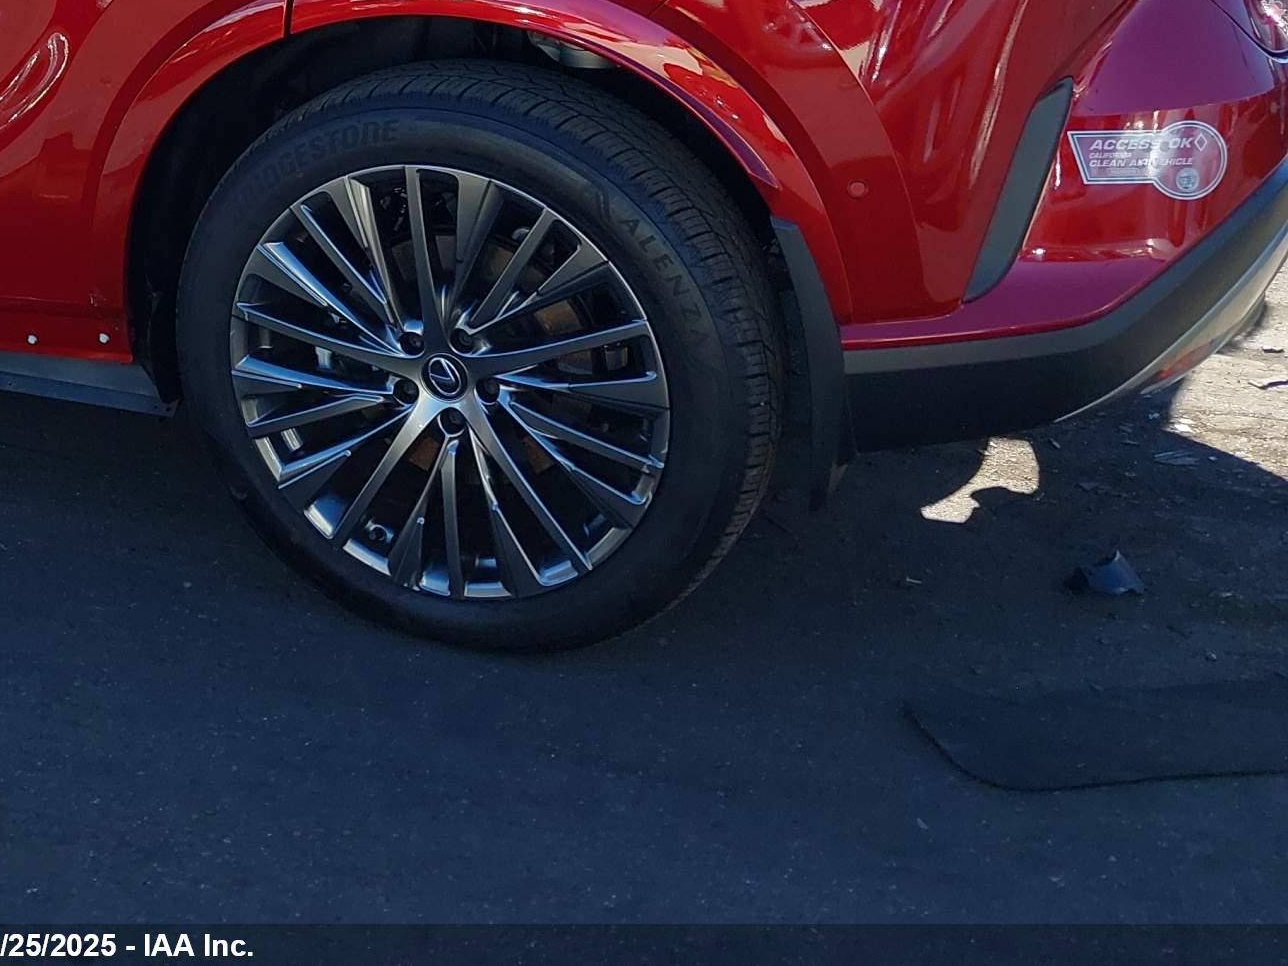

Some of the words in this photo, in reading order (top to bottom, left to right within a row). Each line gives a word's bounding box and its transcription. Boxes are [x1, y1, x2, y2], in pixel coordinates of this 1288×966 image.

[238, 118, 399, 208] IDGESTONE
[1089, 138, 1161, 150] ACCESS
[1168, 137, 1193, 149] OK
[1089, 159, 1126, 167] CLEAN
[1129, 158, 1149, 166] AIR
[617, 218, 712, 345] ALENZA
